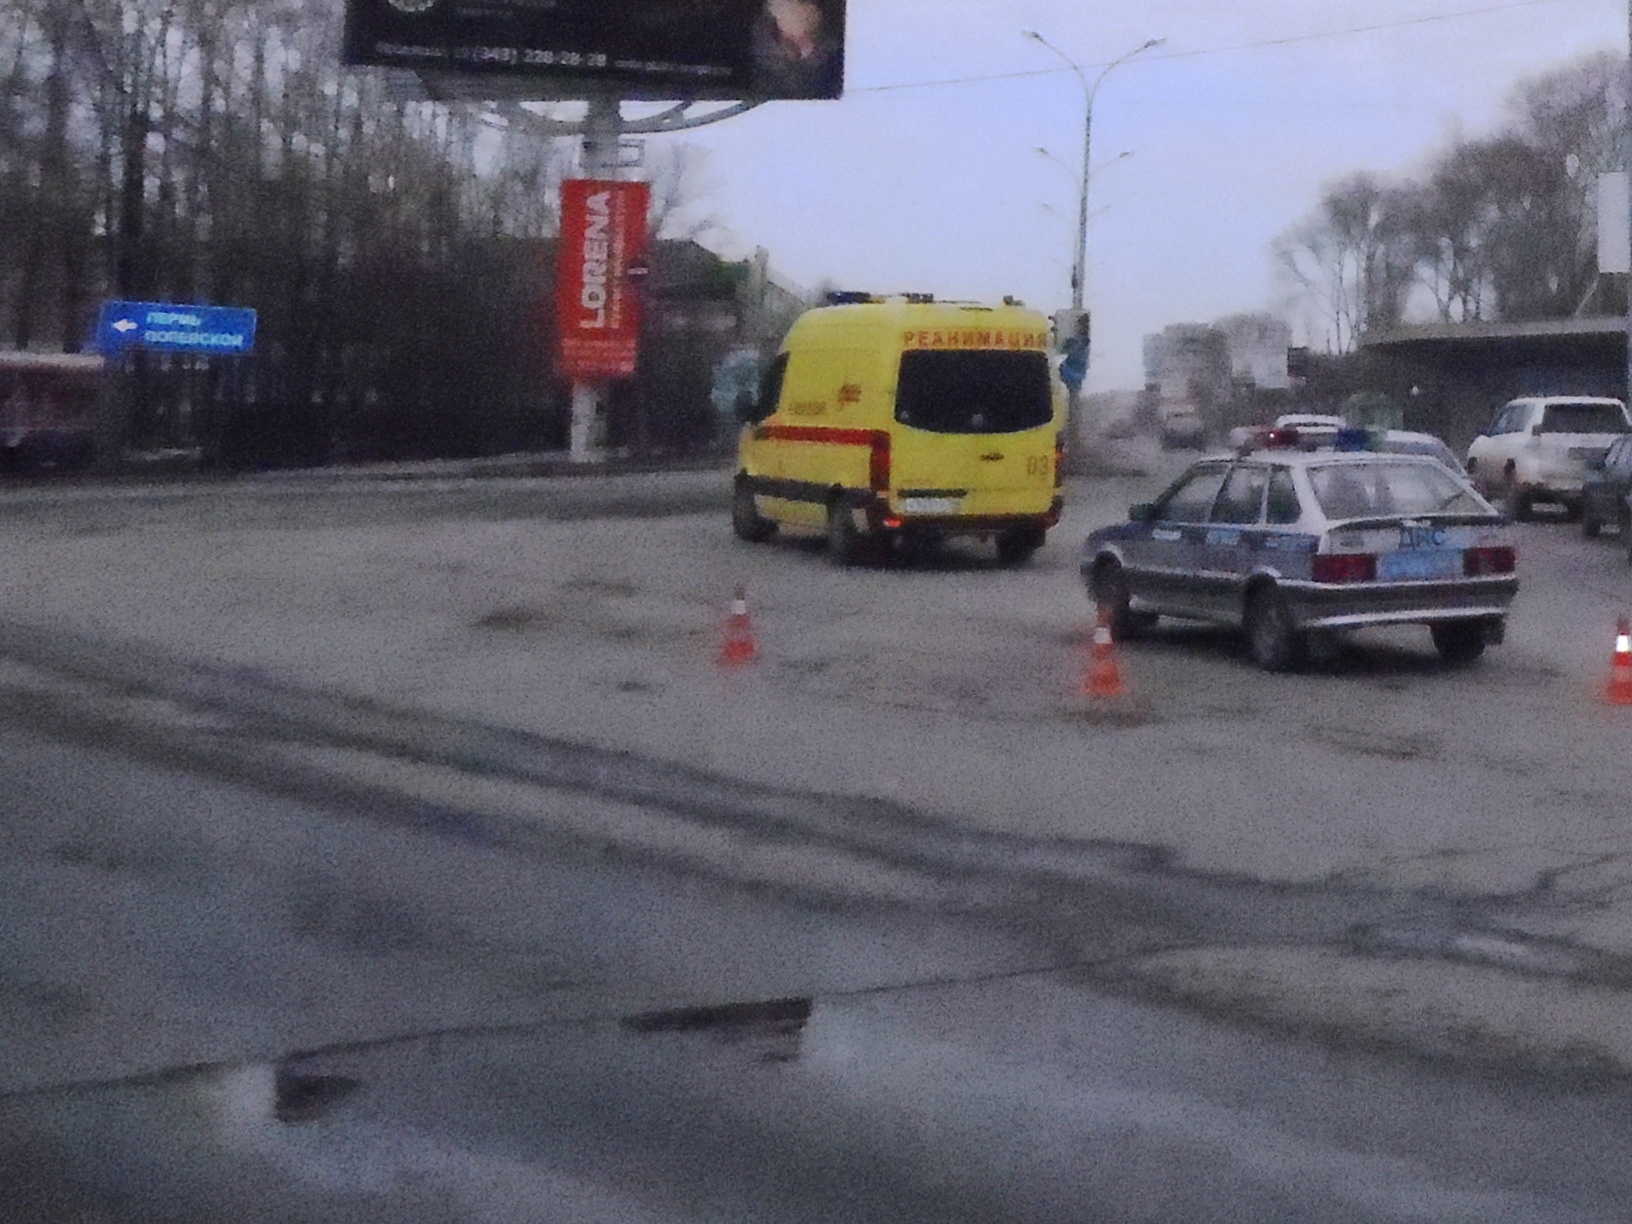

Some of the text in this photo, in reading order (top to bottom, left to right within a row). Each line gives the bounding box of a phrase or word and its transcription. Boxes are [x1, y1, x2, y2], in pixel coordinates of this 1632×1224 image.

[579, 191, 611, 329] LORENA
[903, 330, 1047, 350] РЕАНИМАЦИЯ
[1026, 455, 1049, 476] 03
